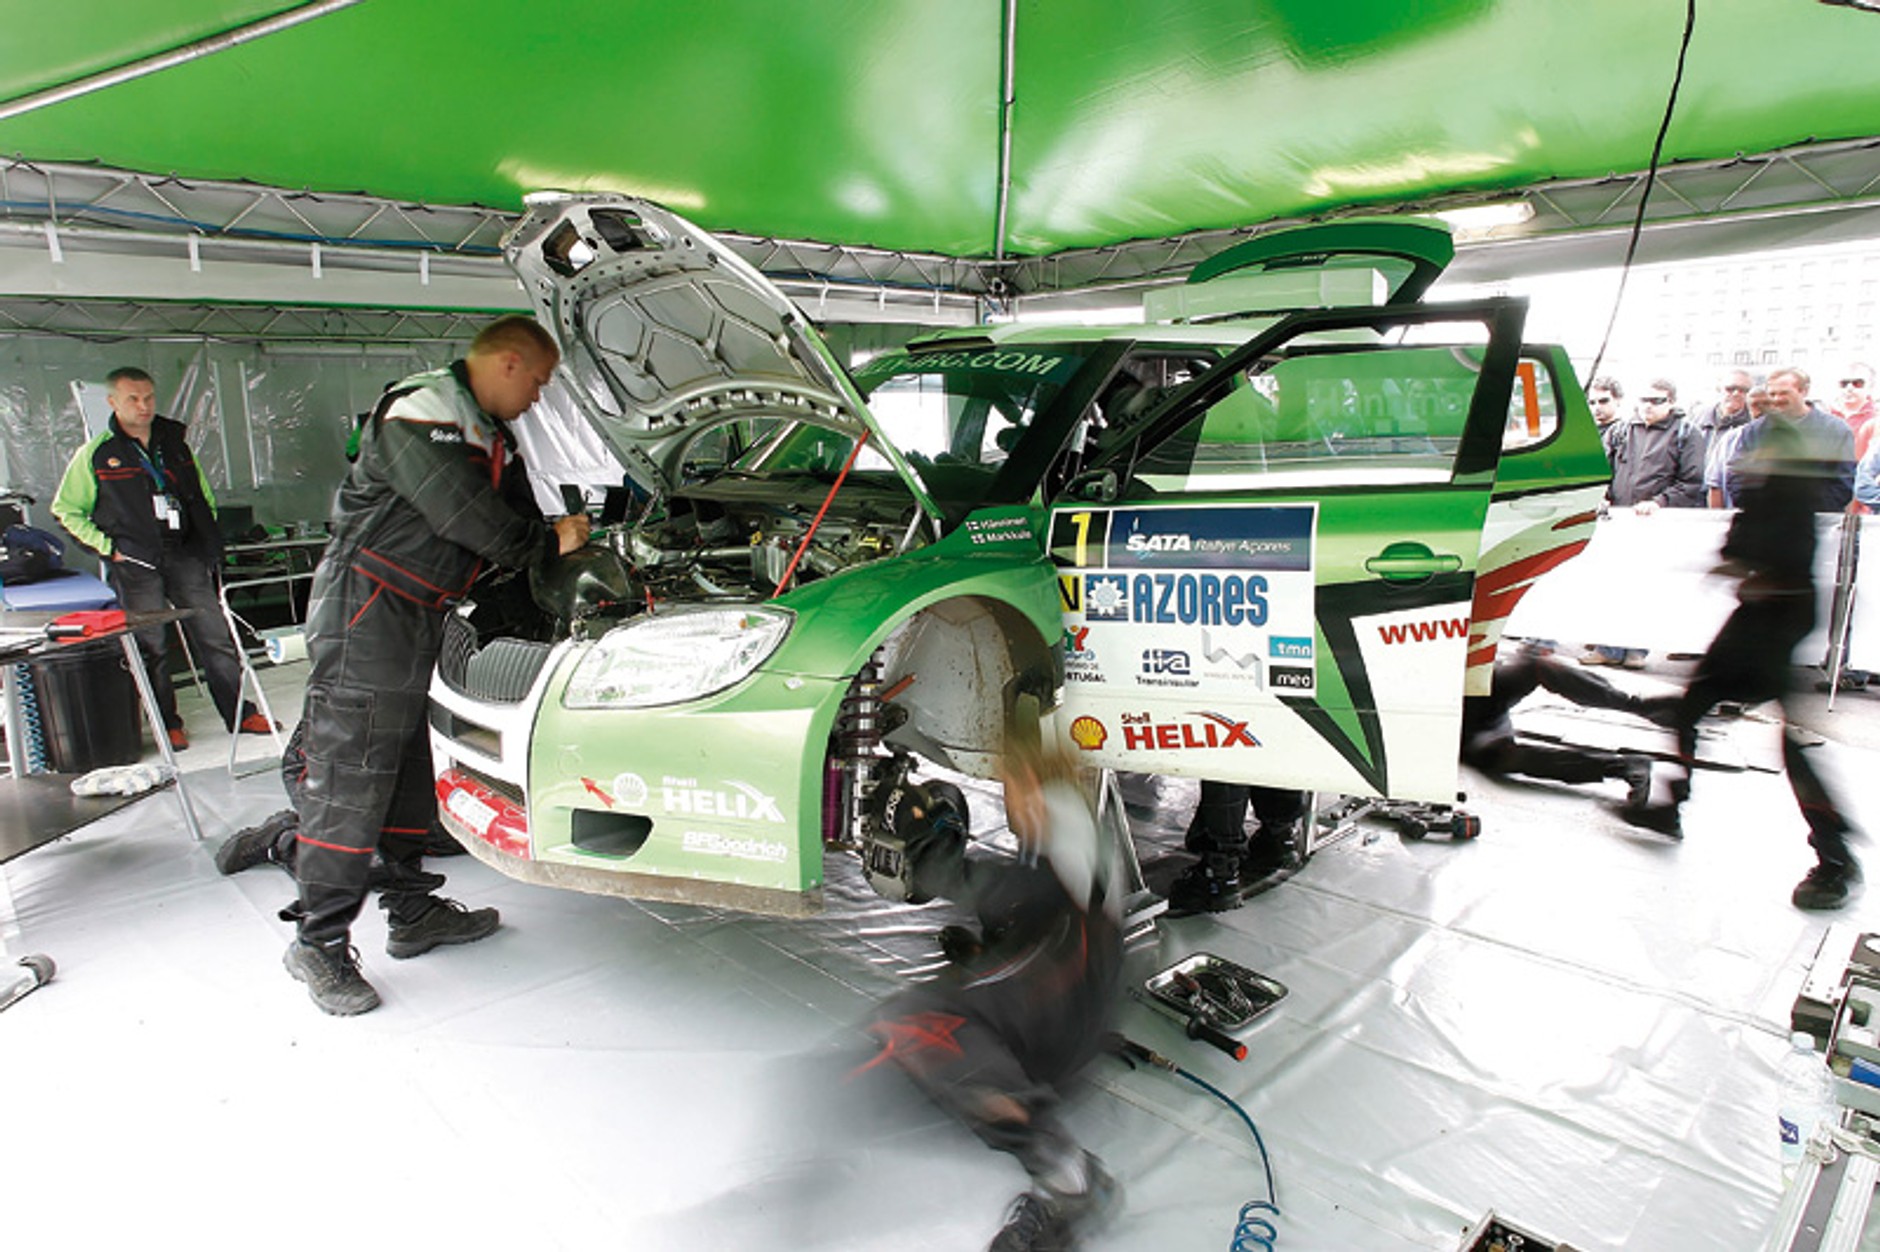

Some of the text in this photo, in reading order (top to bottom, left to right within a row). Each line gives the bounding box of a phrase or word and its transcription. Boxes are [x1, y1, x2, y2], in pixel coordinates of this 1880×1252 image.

[1071, 512, 1092, 568] 1
[1126, 533, 1191, 552] SATA
[1277, 642, 1311, 657] tmn
[1121, 711, 1151, 725] Shell
[1121, 713, 1261, 750] HELIX
[662, 775, 698, 788] Shell
[662, 782, 786, 823] HELIX
